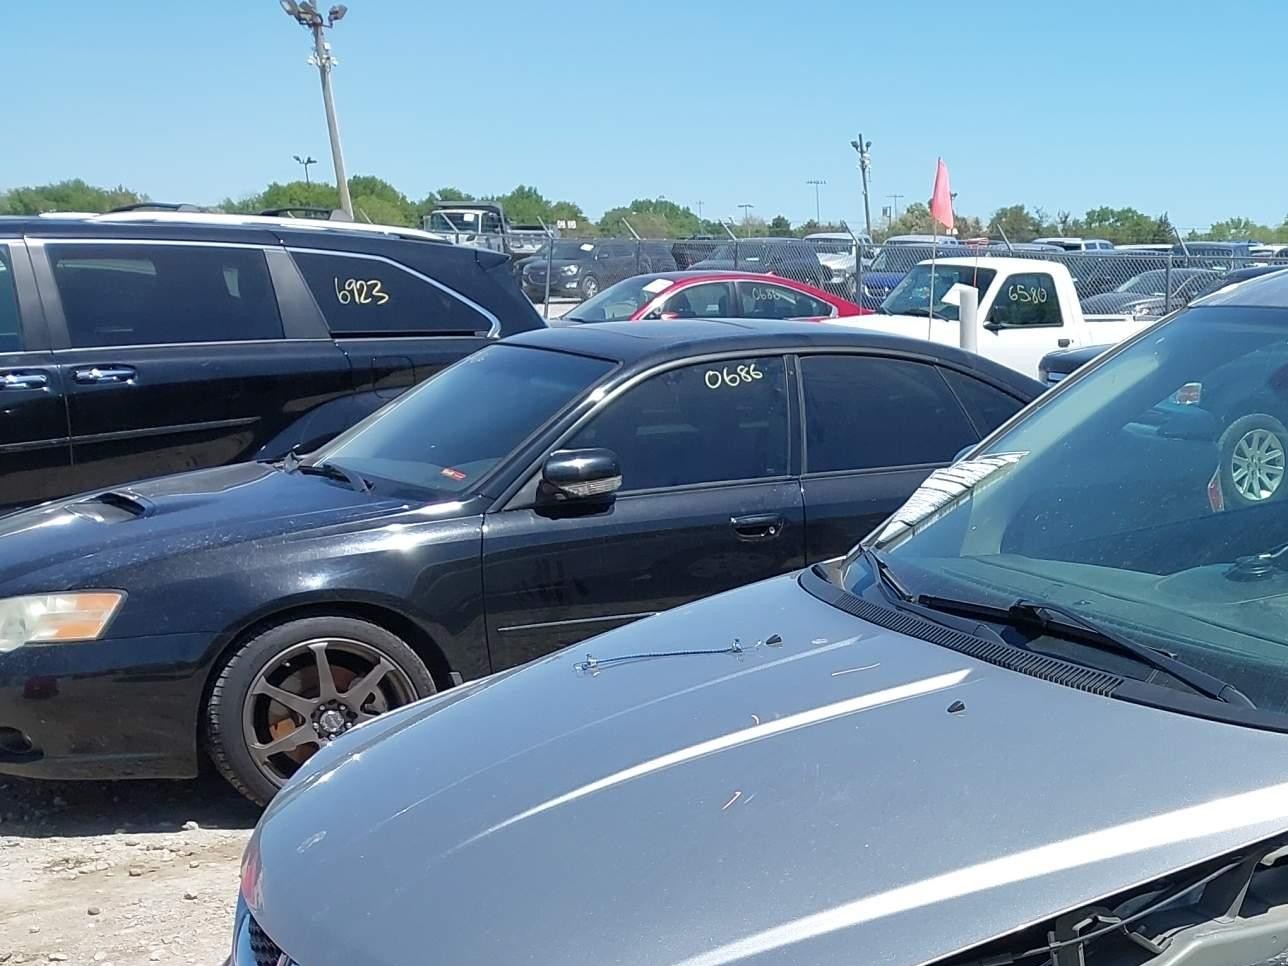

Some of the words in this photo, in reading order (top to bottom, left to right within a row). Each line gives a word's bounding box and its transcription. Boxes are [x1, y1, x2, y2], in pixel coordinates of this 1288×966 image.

[334, 276, 389, 305] 6923
[1008, 284, 1048, 304] 6580
[705, 363, 763, 389] 0686
